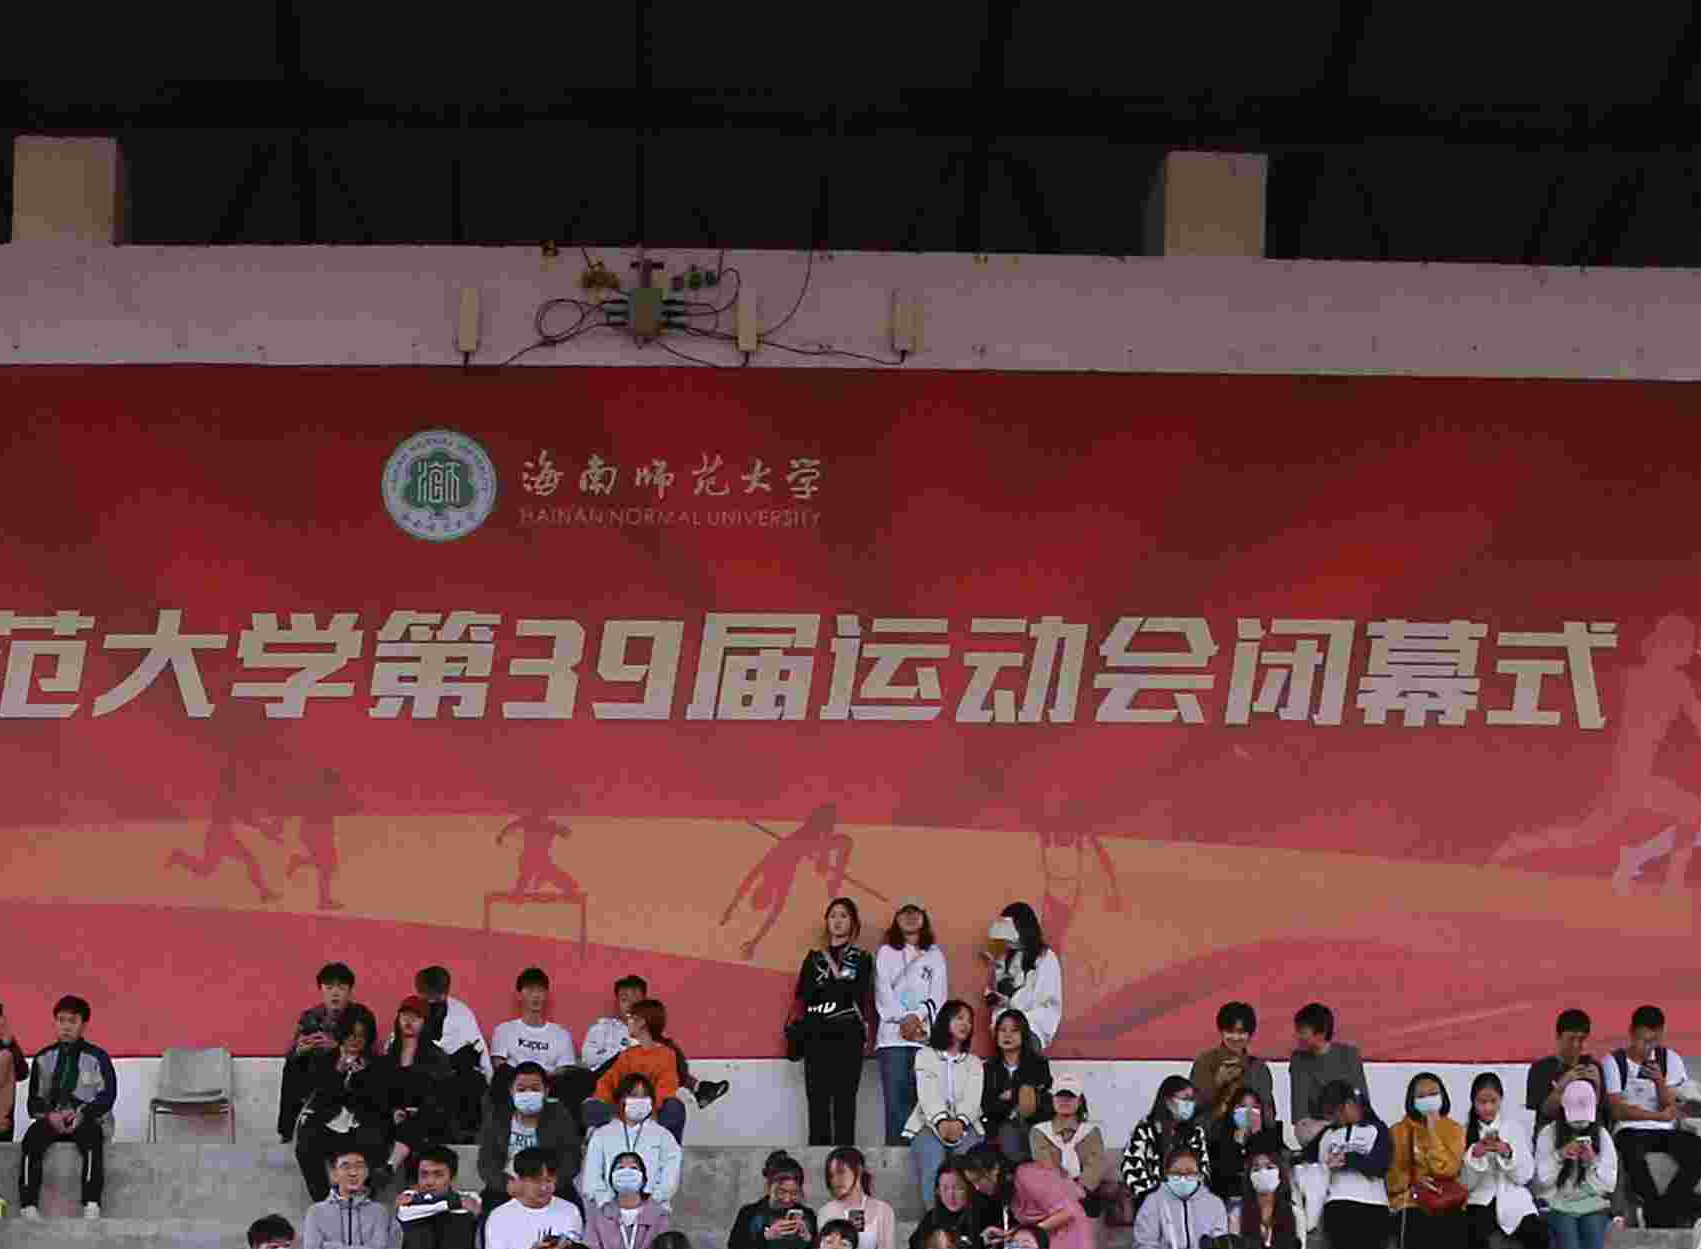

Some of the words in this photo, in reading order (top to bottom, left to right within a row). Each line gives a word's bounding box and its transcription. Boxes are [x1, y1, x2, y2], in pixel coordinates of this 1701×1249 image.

[521, 449, 822, 499] 海南师范大学
[518, 506, 607, 528] HAINAN
[610, 507, 699, 528] NORMAL
[708, 509, 821, 529] UNIVERSITY
[517, 1037, 550, 1051] Kappa
